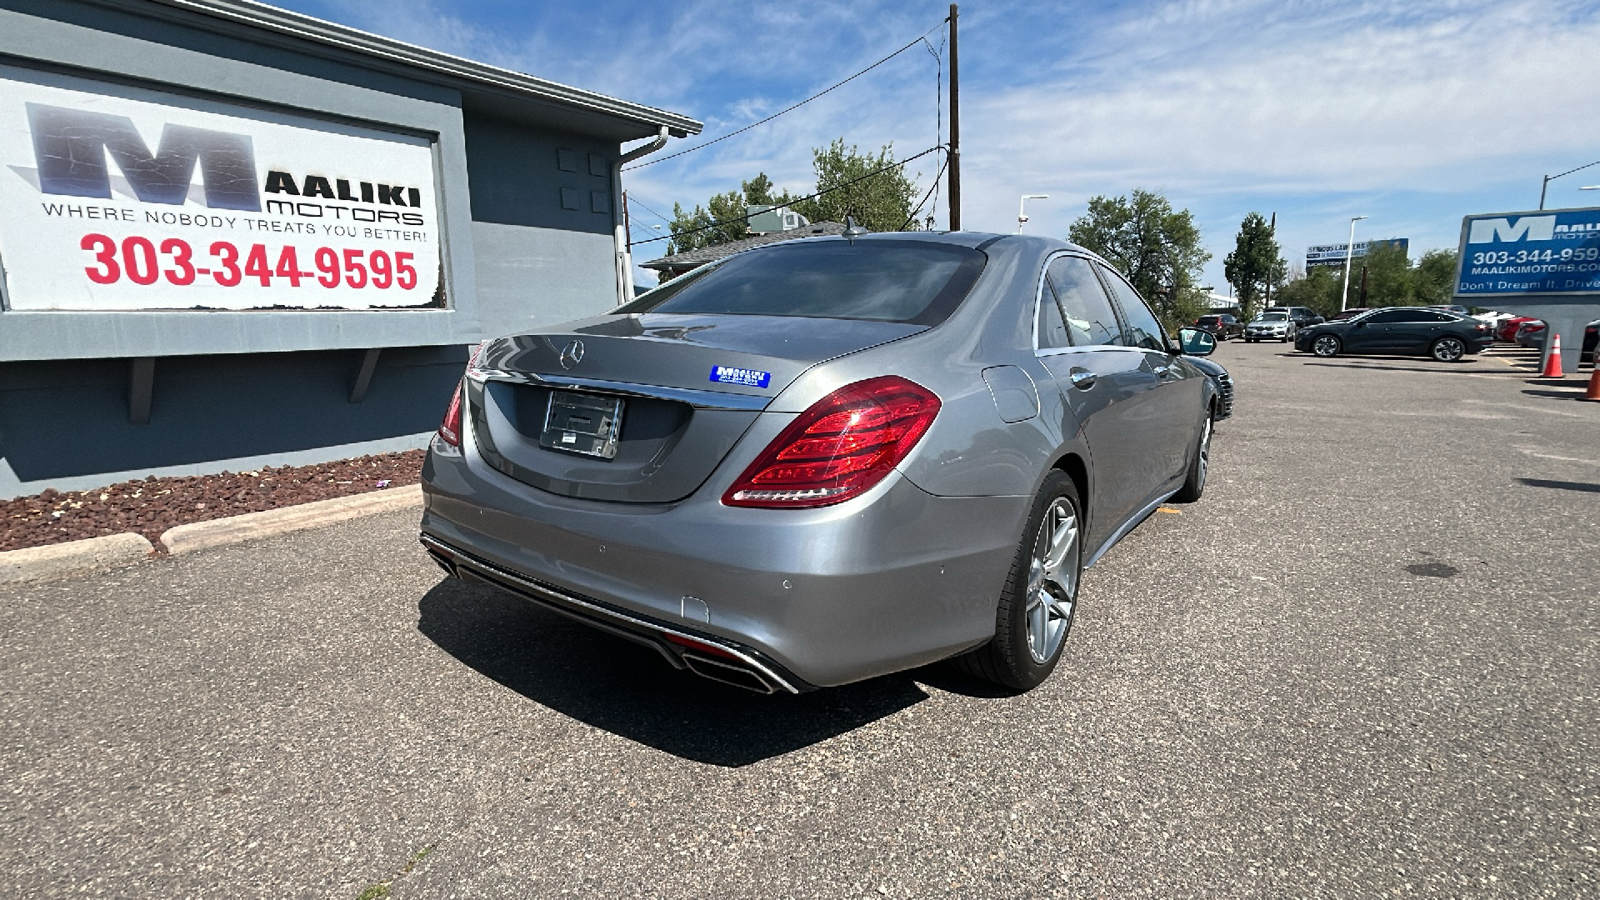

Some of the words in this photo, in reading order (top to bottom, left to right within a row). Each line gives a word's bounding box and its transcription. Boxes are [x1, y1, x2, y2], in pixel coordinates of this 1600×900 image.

[42, 202, 136, 222] WHERE
[145, 210, 236, 229] NOBODY
[244, 218, 316, 235] TREATS
[322, 224, 357, 238] YOU
[363, 227, 428, 243] BETTER!
[266, 199, 424, 226] MOTORS
[1335, 243, 1365, 251] LAWERS
[1473, 247, 1600, 265] 303-344-959
[80, 232, 418, 290] 303-344-9595
[1460, 281, 1493, 291] Don't
[1498, 281, 1541, 290] Dream
